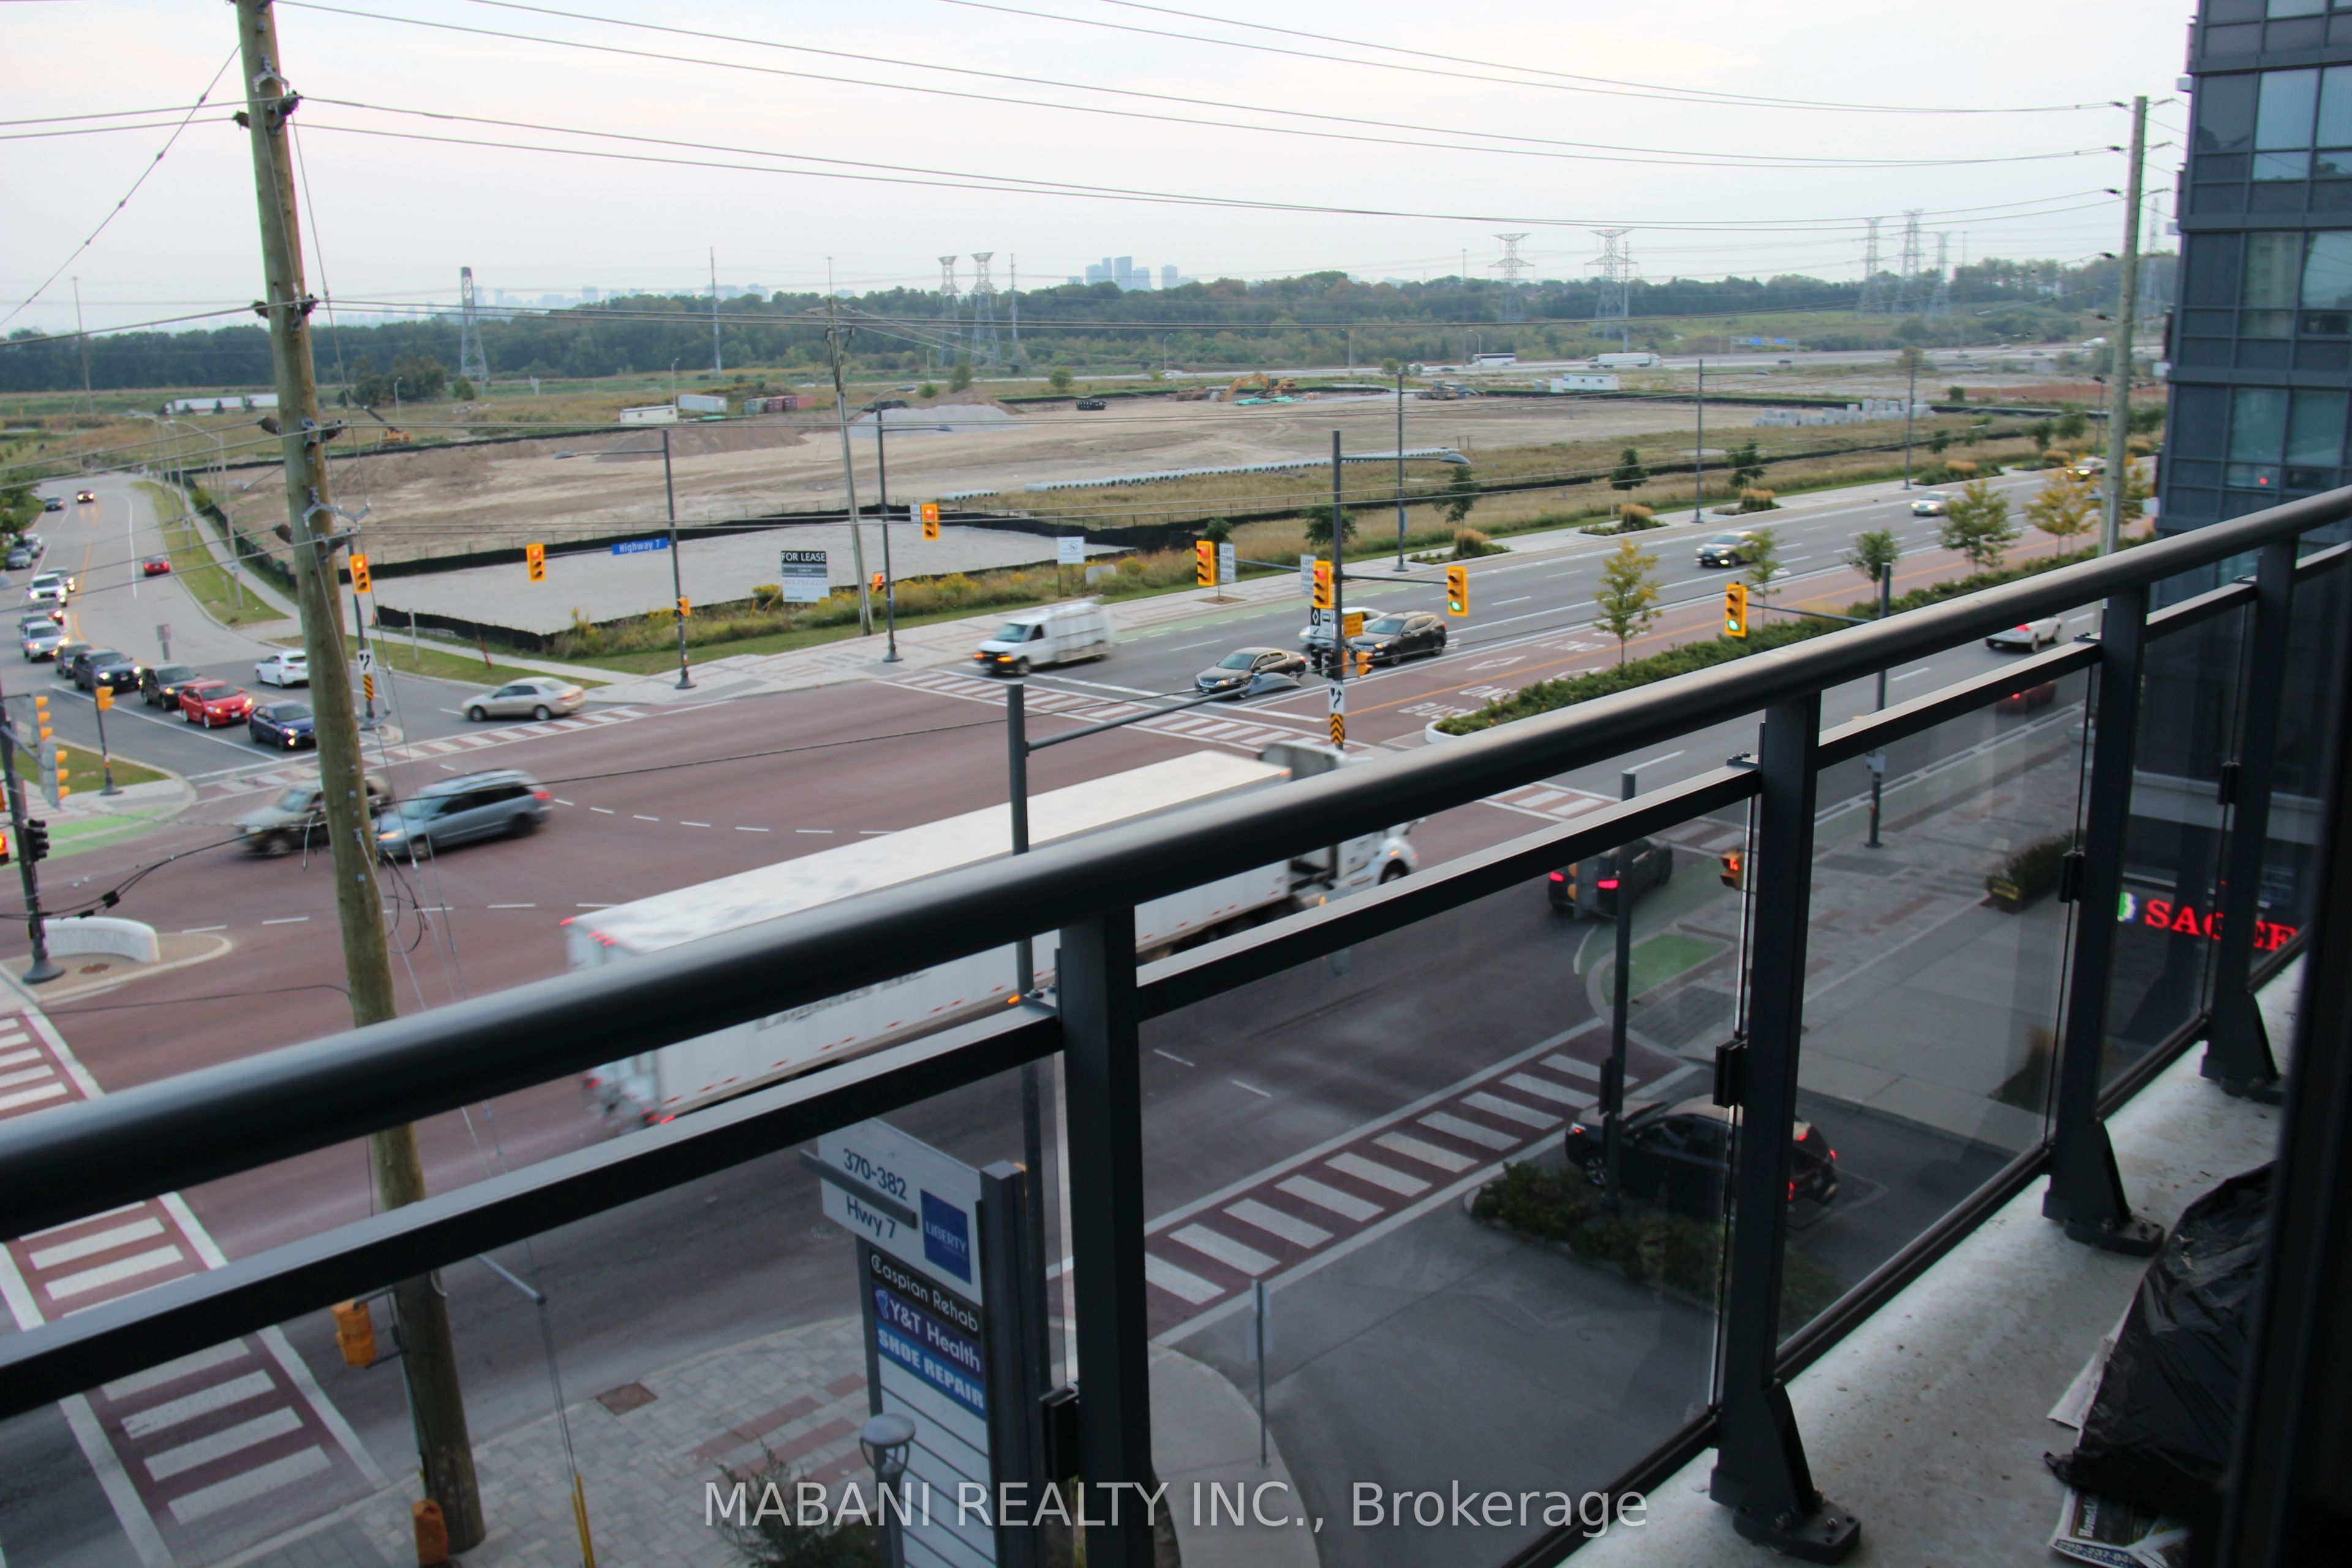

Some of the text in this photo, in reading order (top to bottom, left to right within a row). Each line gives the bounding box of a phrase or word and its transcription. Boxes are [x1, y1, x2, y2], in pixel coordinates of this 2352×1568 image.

[619, 540, 660, 553] Highway 7
[781, 552, 826, 562] FOR LEASE
[843, 1148, 908, 1202] 370-382
[846, 1194, 897, 1239] Hwy 7
[925, 1220, 967, 1254] LIBERTY
[870, 1254, 979, 1332] Caspian Rehab
[889, 1298, 981, 1372] Y&T Health
[878, 1329, 984, 1410] SHOE REPAIR
